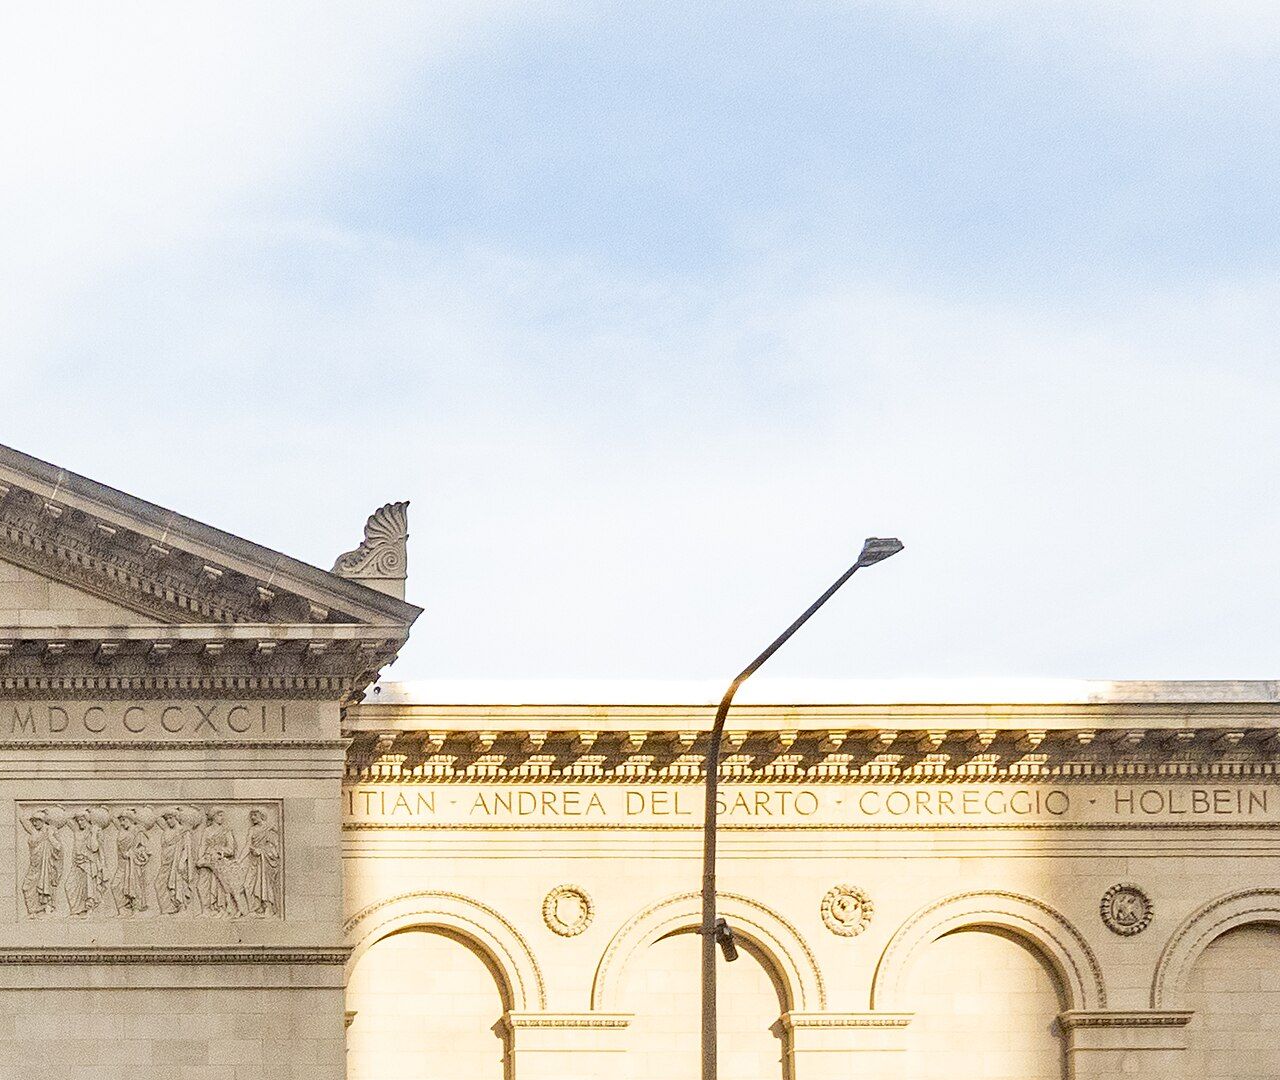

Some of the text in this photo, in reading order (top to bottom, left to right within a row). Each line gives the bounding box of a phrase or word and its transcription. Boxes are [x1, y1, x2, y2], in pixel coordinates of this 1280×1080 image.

[343, 790, 435, 816] ITIAN
[469, 790, 819, 816] ANDREA DEL SARTO
[858, 789, 1070, 816] CORREGGIO
[1114, 789, 1268, 815] HOLBEIN
